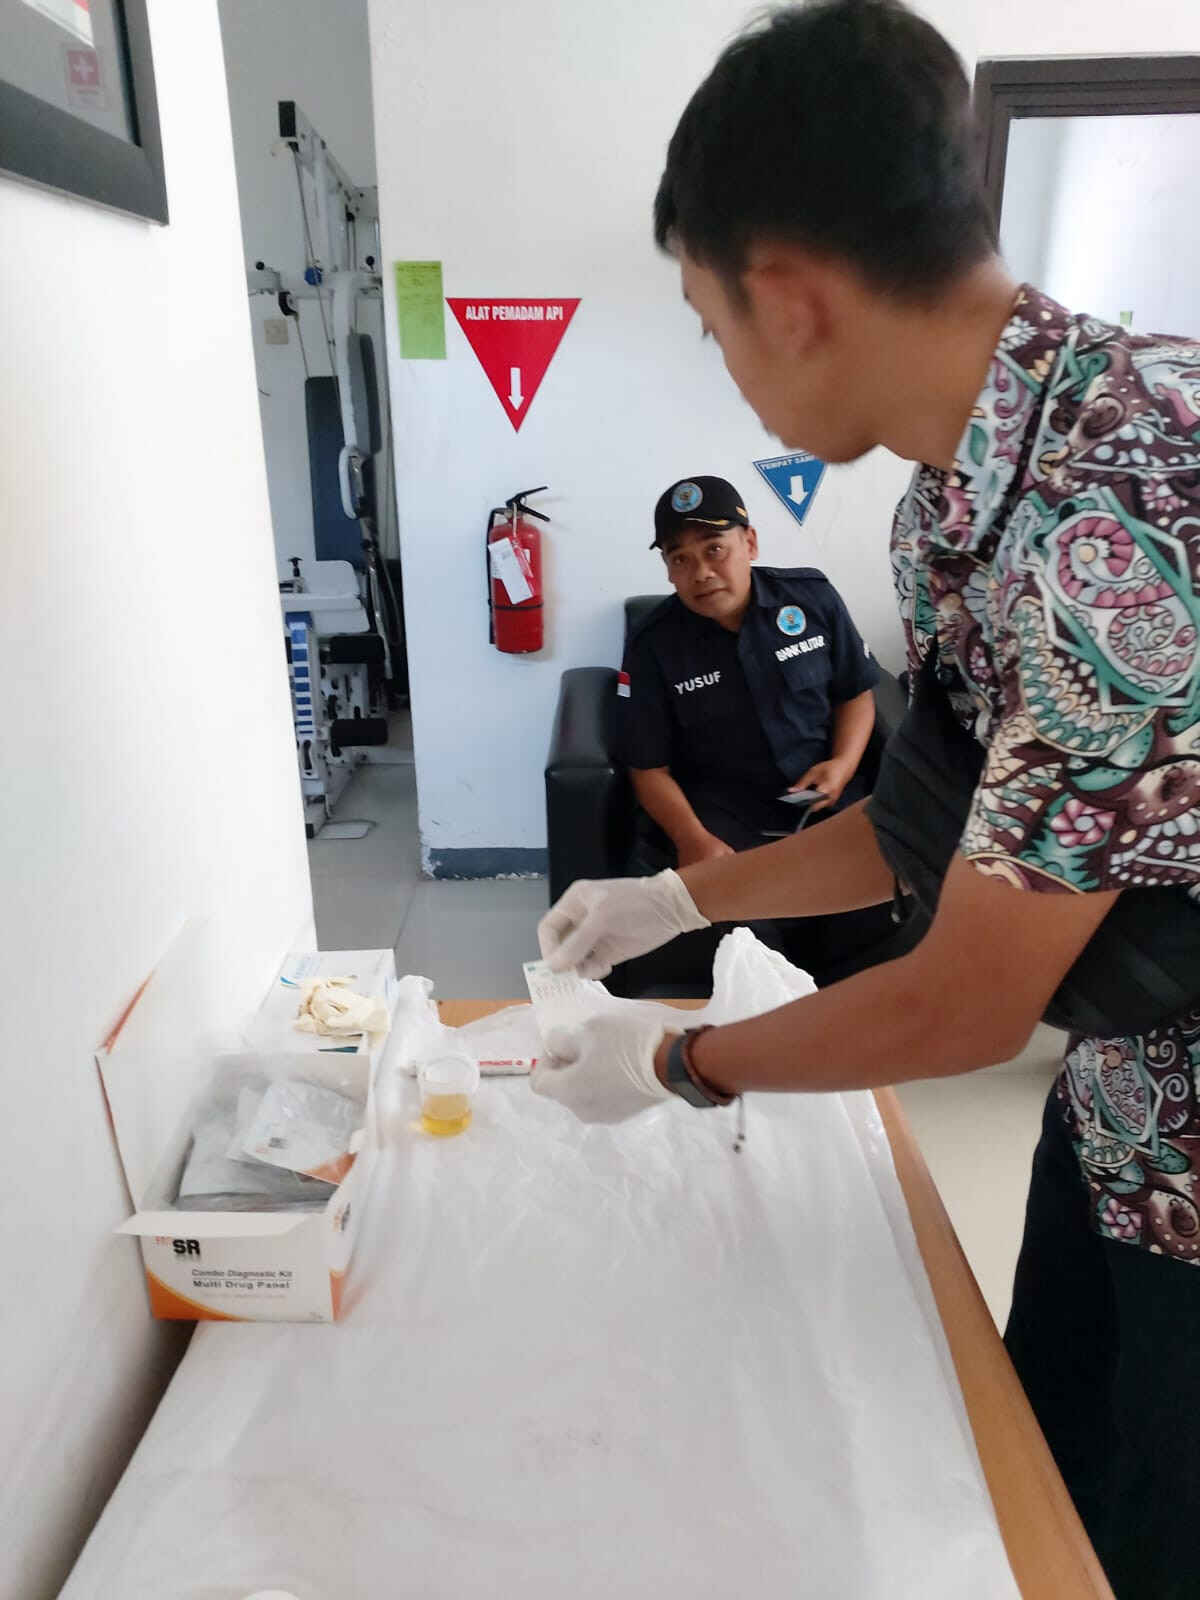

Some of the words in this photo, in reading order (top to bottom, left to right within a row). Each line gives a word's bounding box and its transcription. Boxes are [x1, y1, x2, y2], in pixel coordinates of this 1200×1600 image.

[465, 305, 490, 321] ALAT
[492, 305, 544, 321] PEMADAM
[545, 305, 563, 321] API
[674, 671, 721, 695] YUSUF
[172, 1239, 201, 1255] SR
[279, 1270, 293, 1278] Kit
[192, 1280, 222, 1289] Multi
[225, 1280, 254, 1290] Drug
[256, 1280, 290, 1289] Panel
